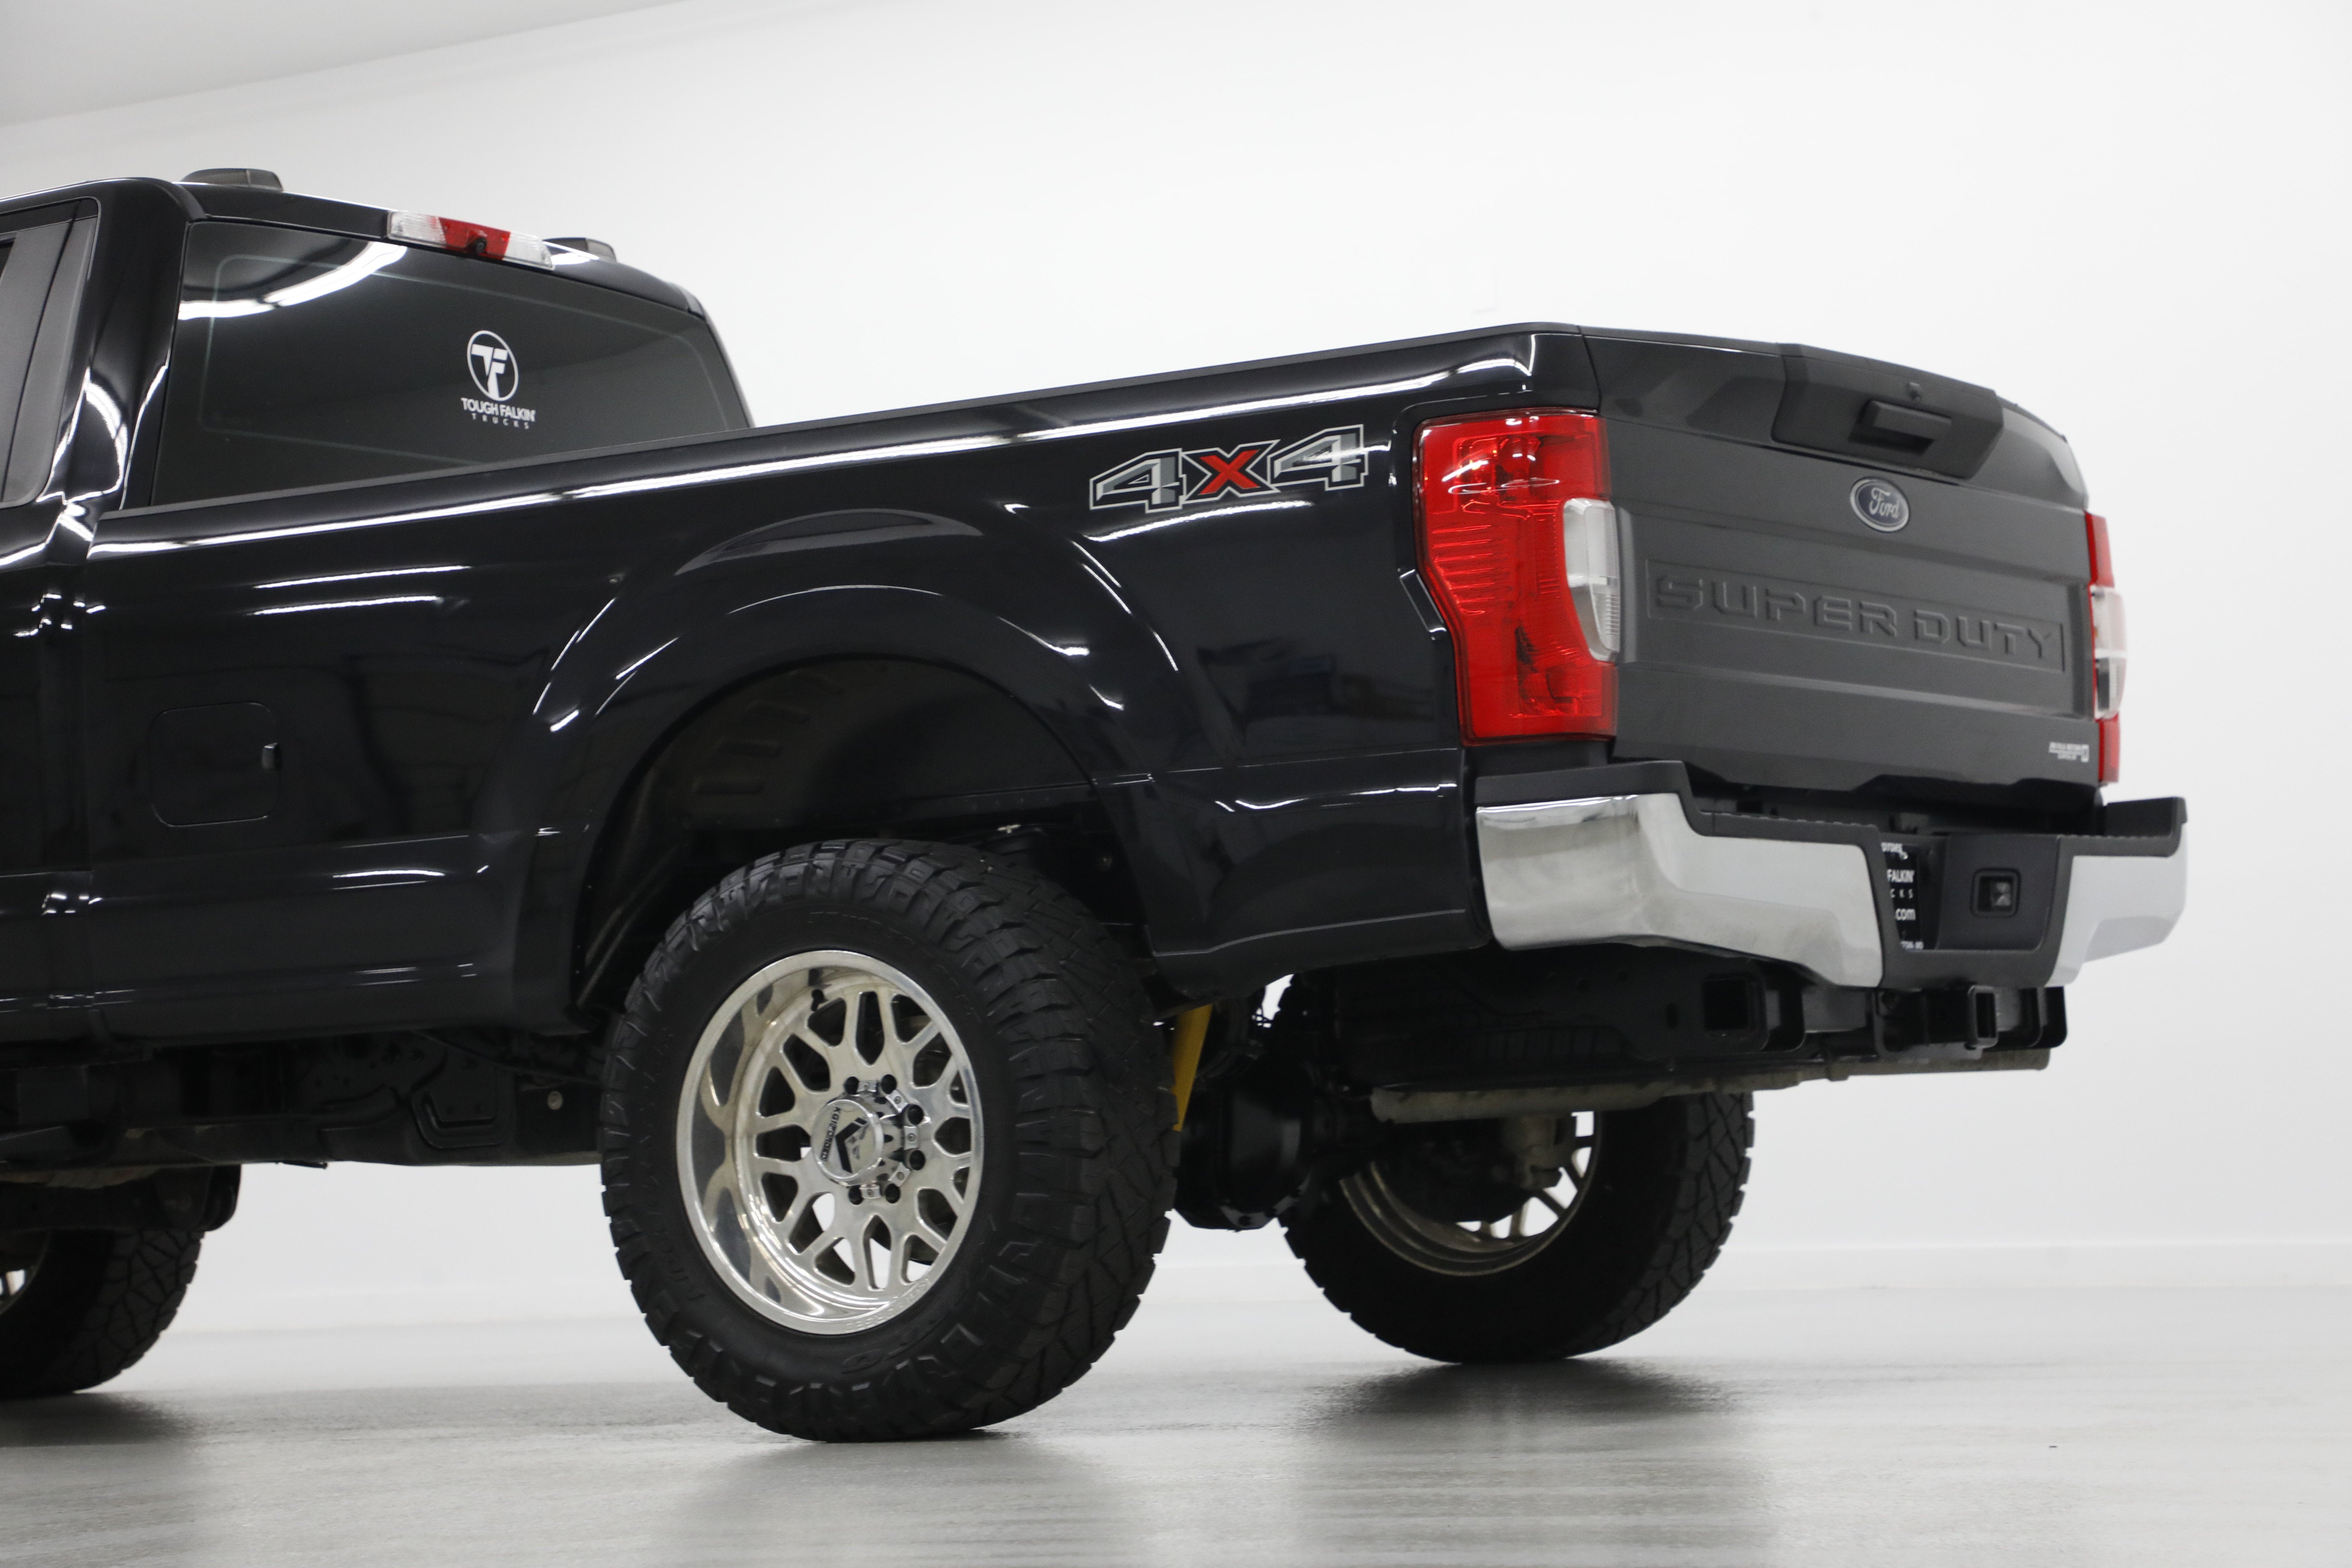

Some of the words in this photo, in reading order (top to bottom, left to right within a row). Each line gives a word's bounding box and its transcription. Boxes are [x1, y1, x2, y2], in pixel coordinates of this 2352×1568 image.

[461, 397, 499, 416] TOUGH
[472, 412, 529, 429] TRUCKS
[1869, 487, 1900, 519] Ford
[1655, 576, 1898, 637] SUPER
[1914, 608, 2052, 659] DUTY
